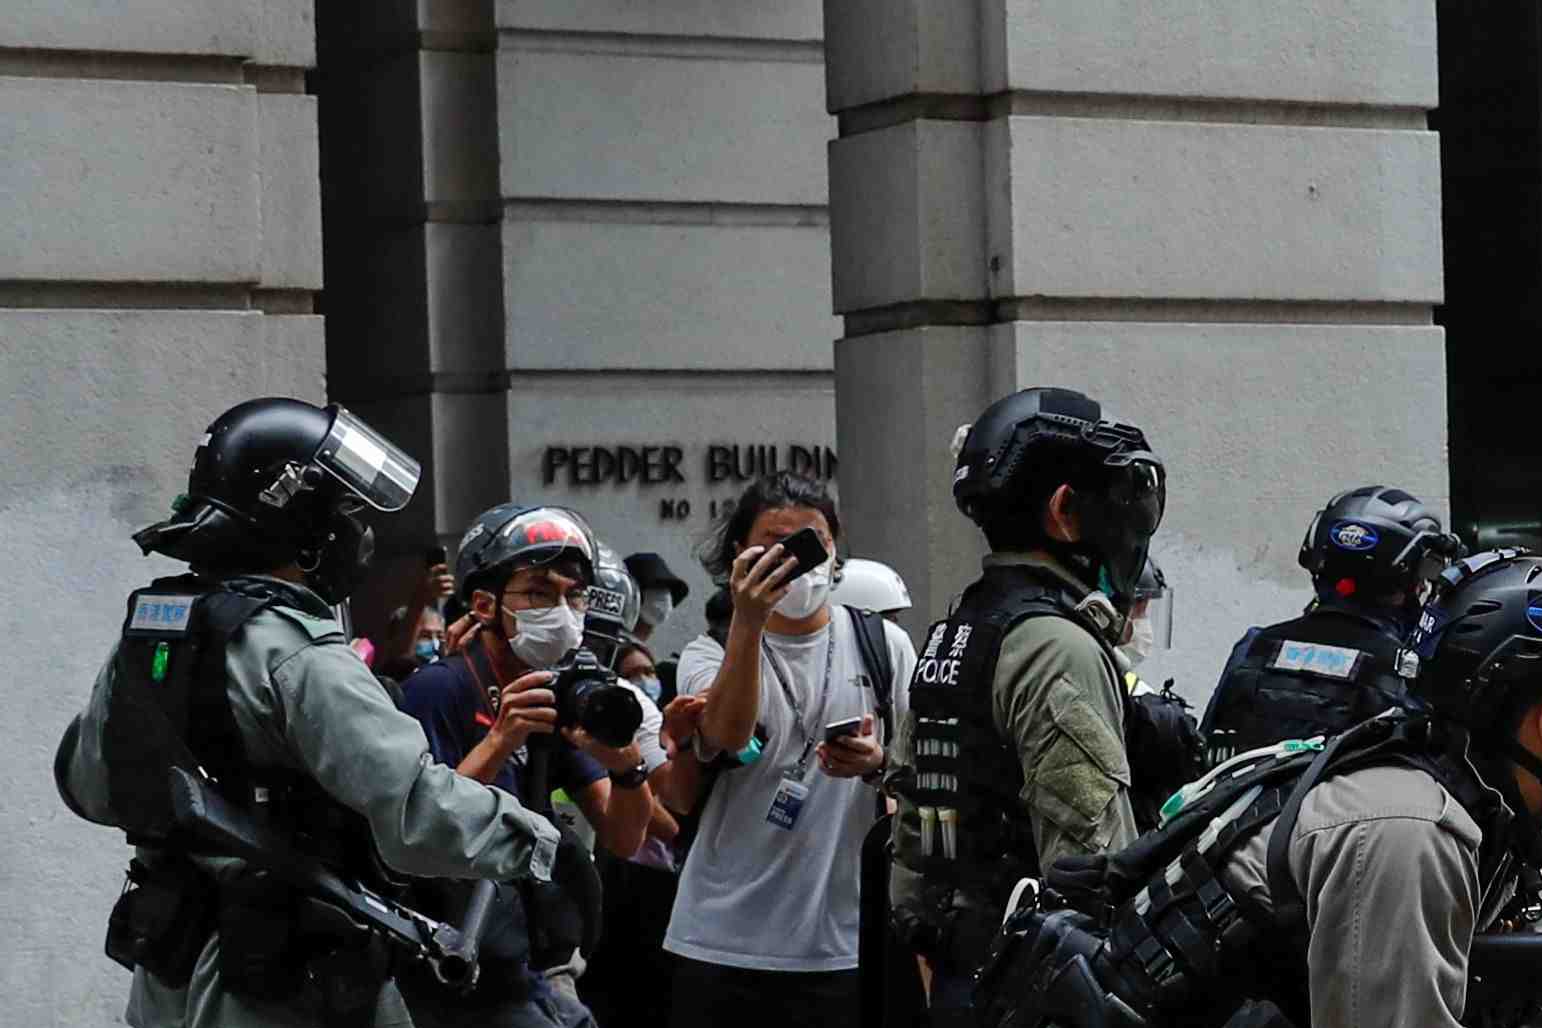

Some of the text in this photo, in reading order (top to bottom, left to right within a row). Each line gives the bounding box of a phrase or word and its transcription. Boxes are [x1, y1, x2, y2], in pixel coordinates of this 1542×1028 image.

[541, 444, 685, 486] PEDDER
[660, 499, 690, 520] NO
[588, 587, 624, 613] PRESS
